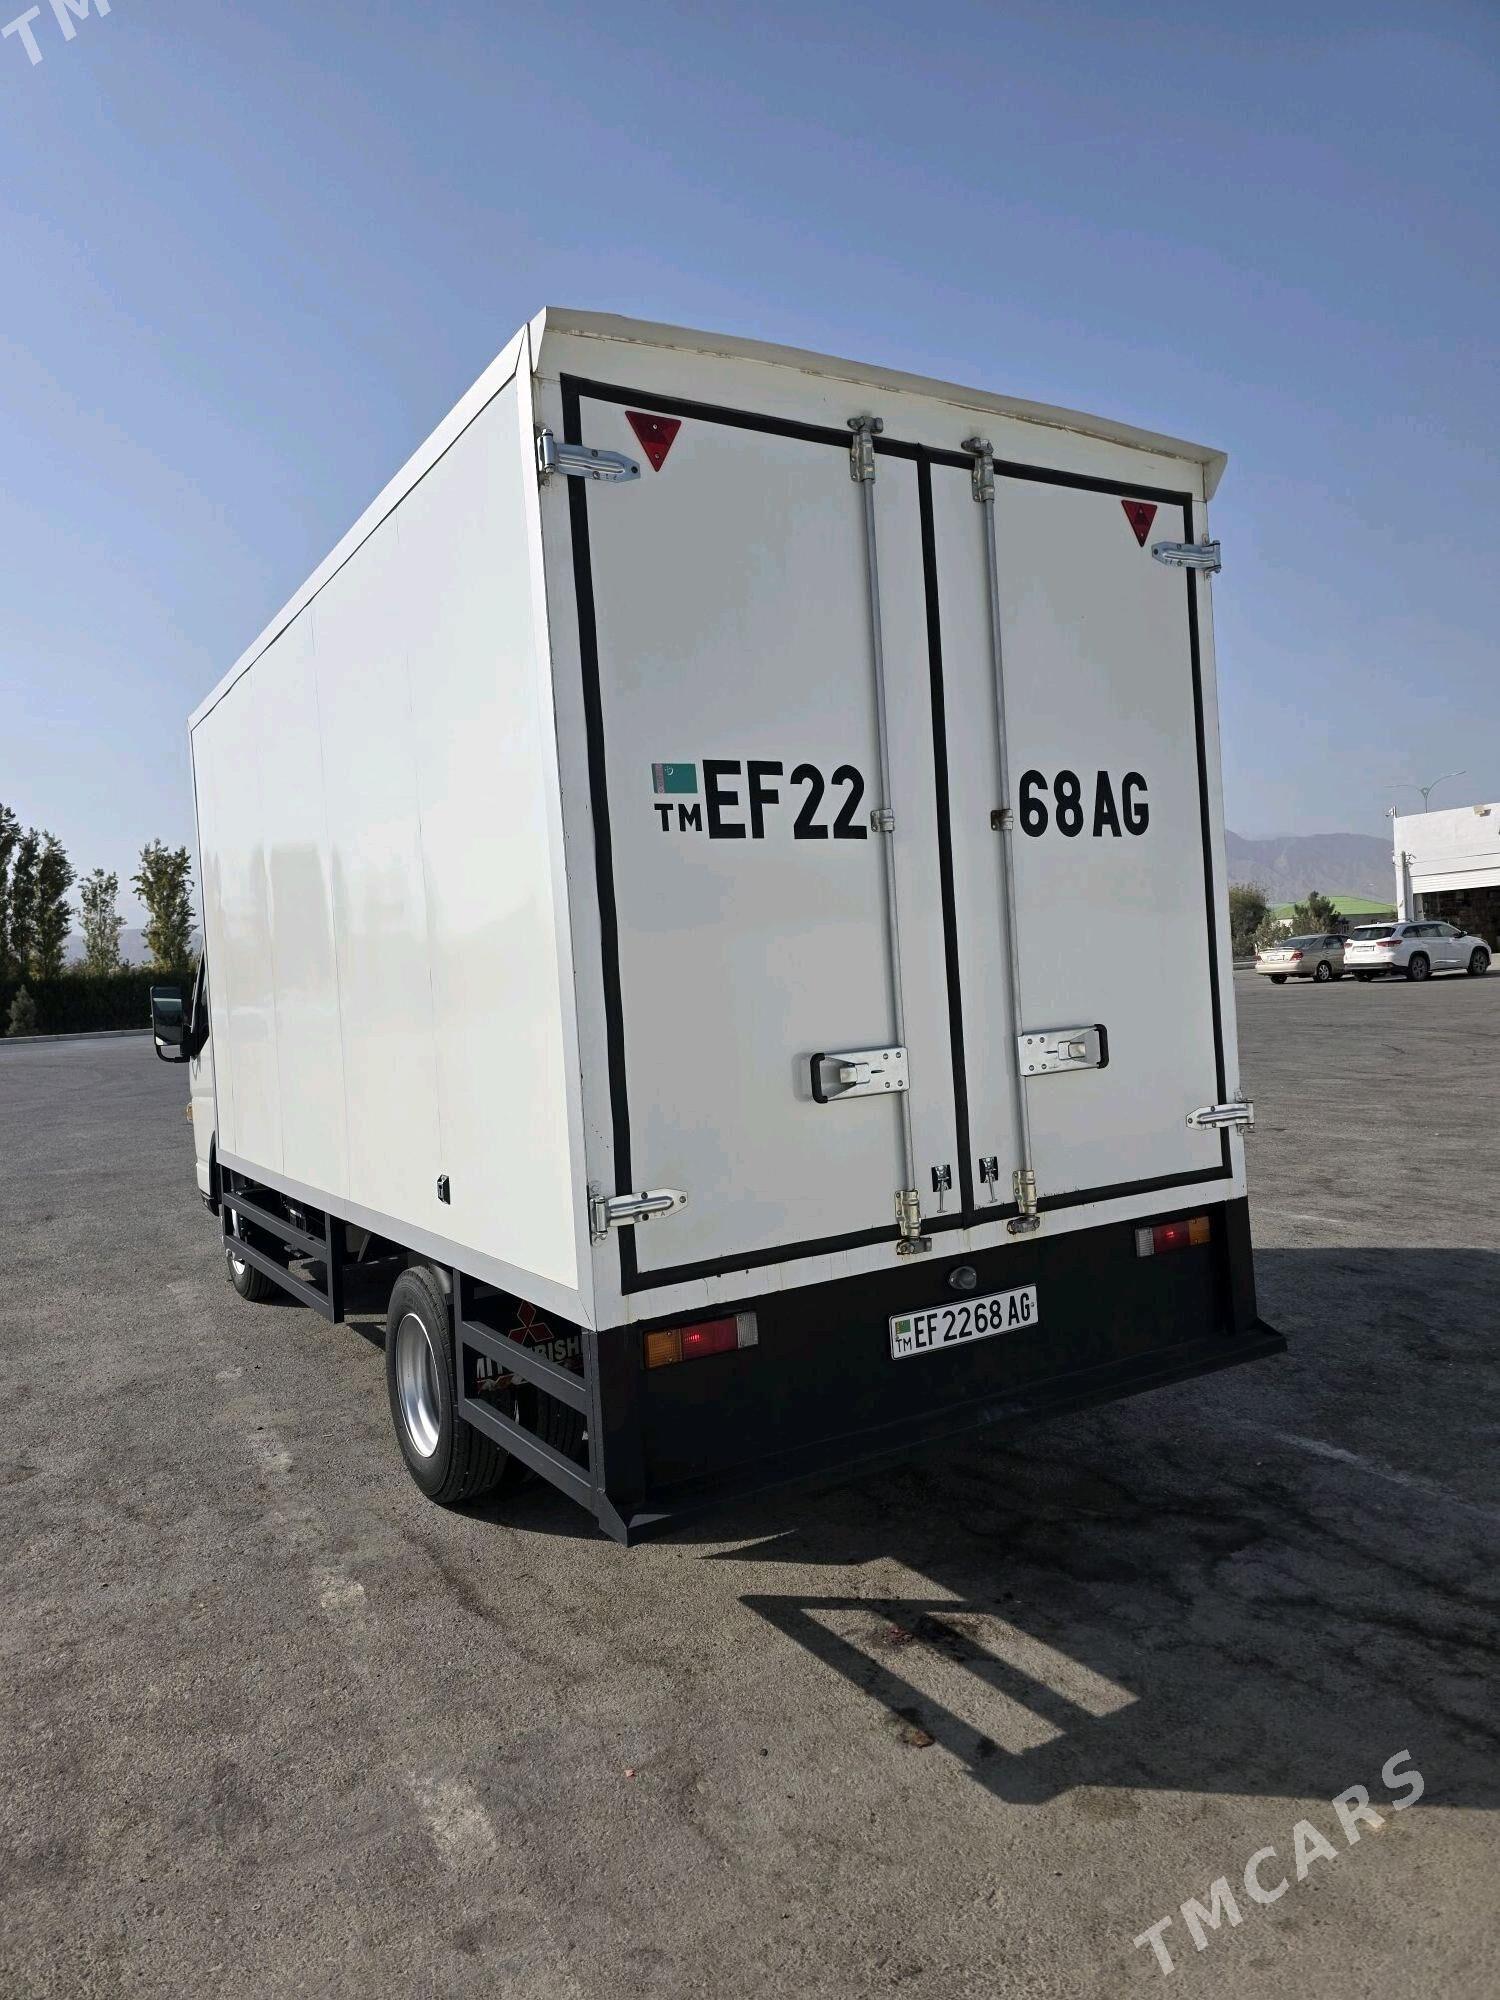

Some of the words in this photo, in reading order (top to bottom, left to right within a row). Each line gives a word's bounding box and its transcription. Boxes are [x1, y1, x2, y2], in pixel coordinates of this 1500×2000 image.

[654, 803, 702, 832] TM
[702, 759, 868, 840] EF22
[896, 1336, 912, 1353] TM
